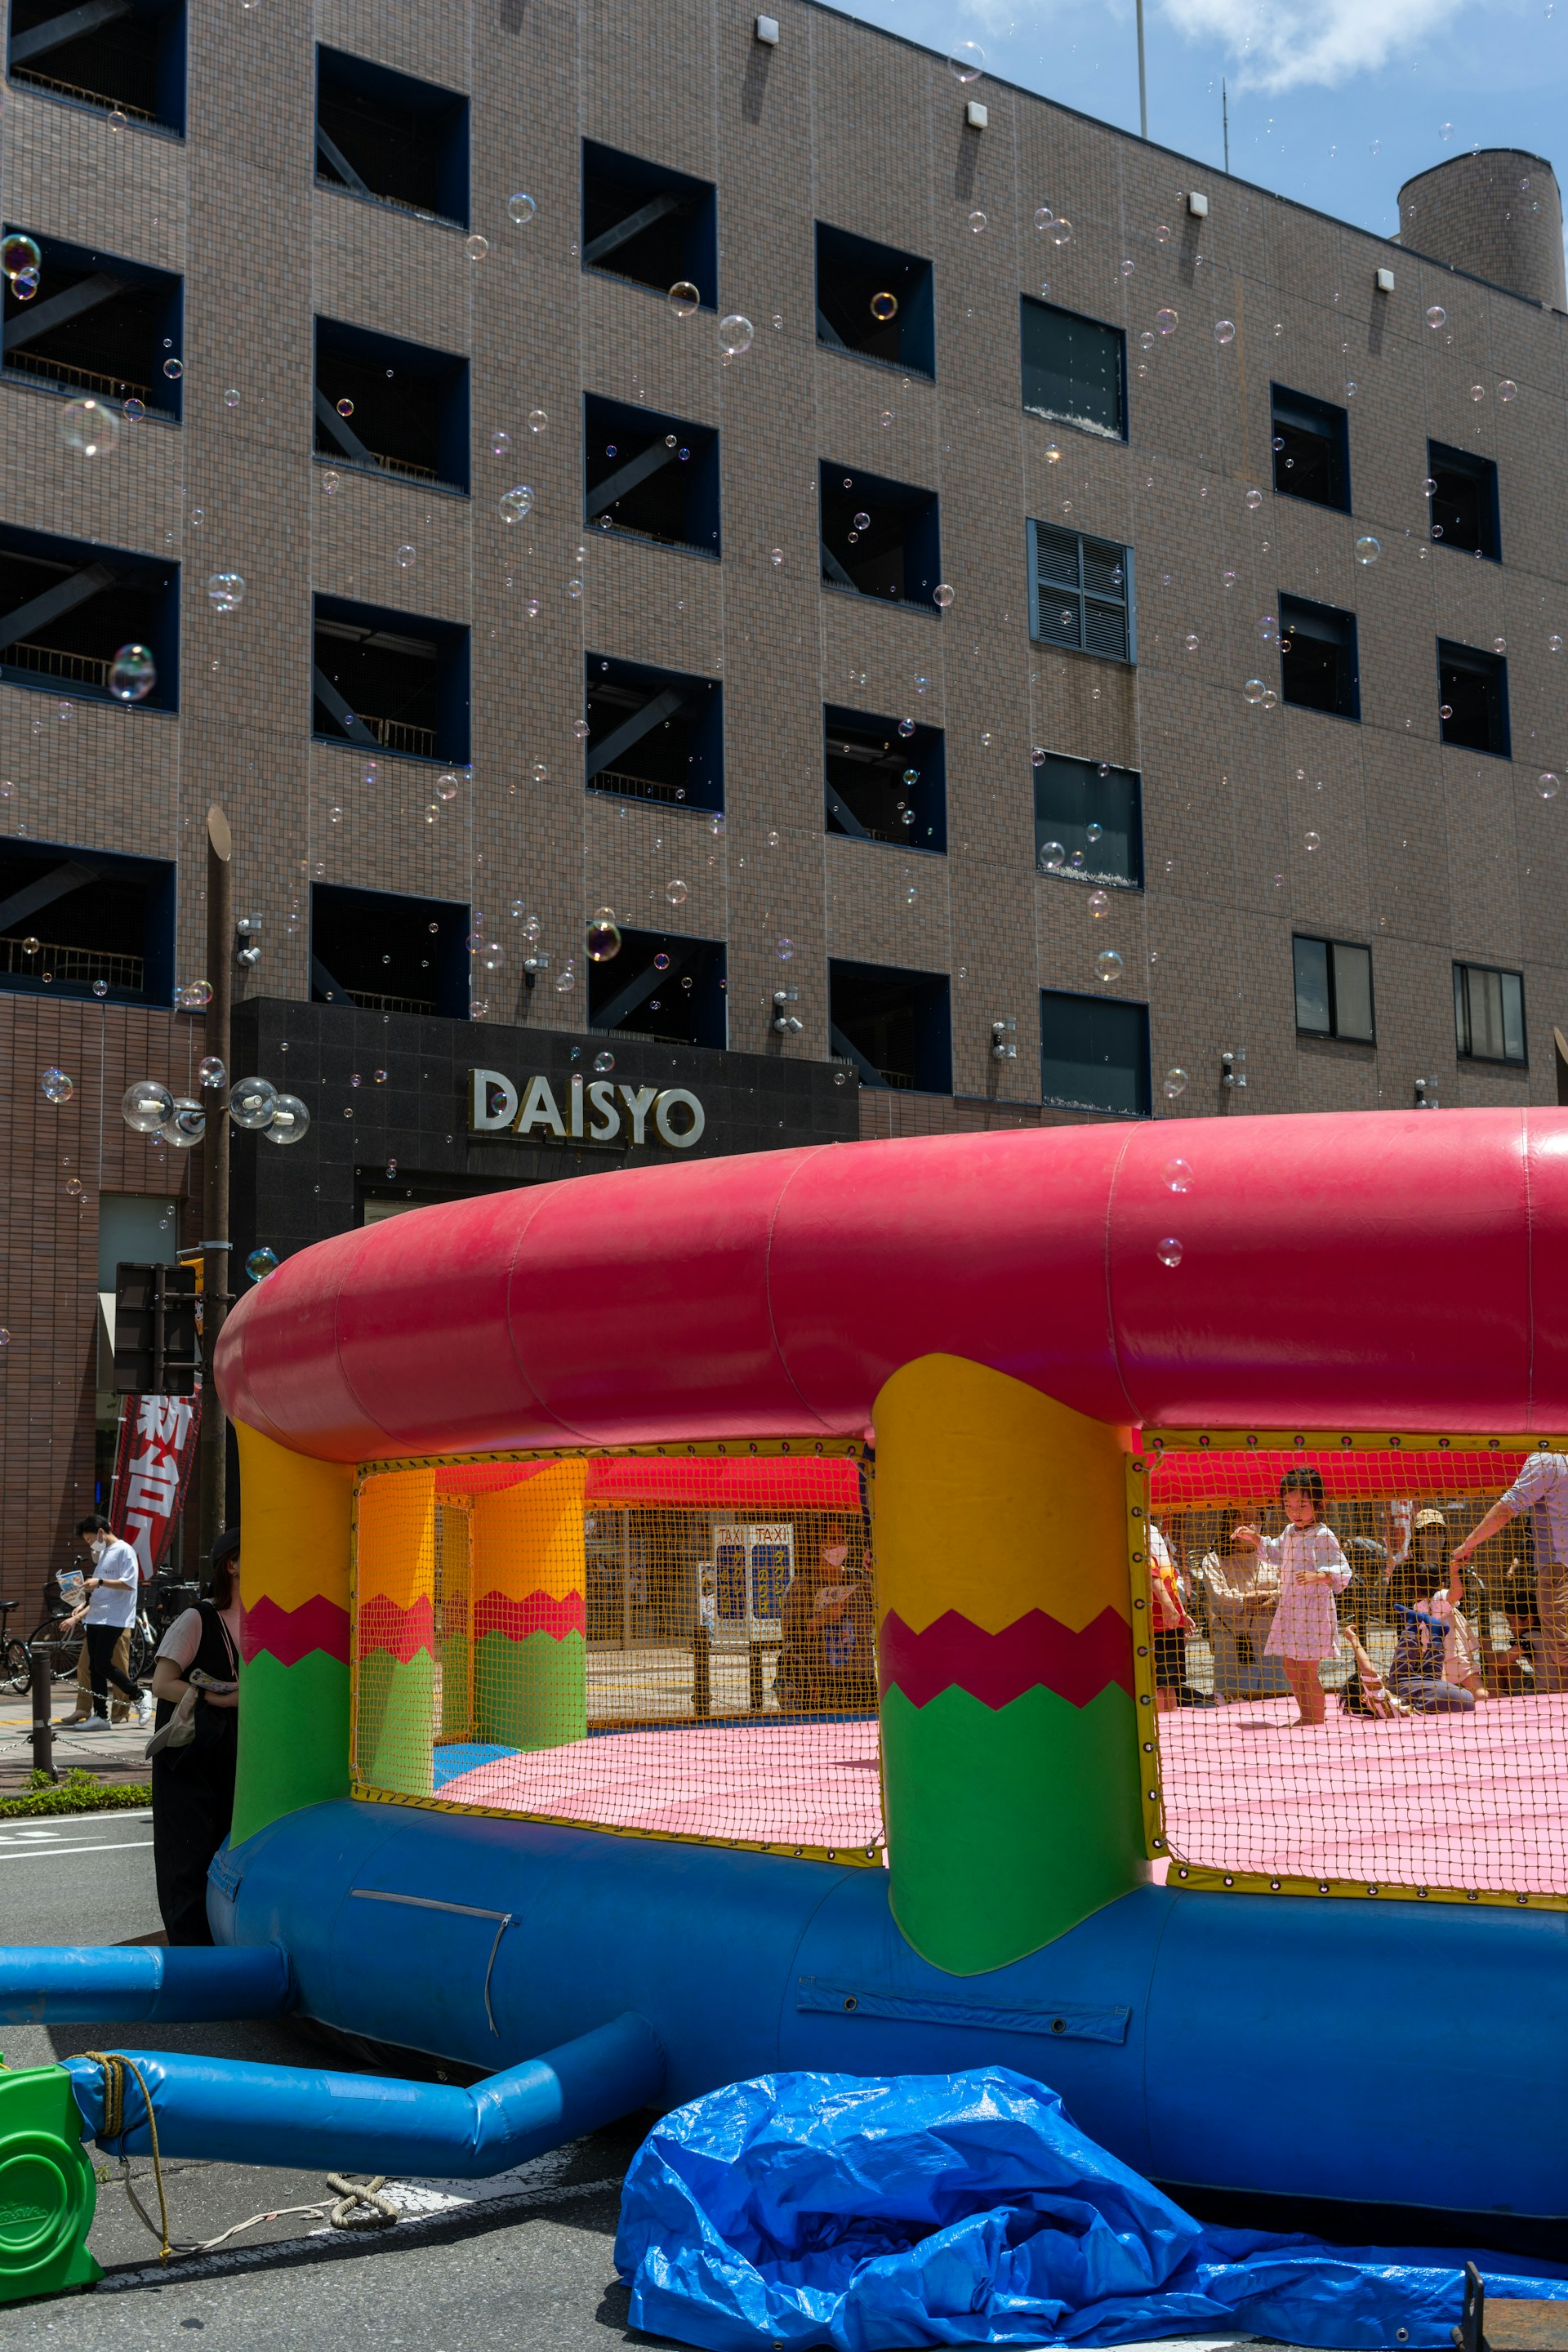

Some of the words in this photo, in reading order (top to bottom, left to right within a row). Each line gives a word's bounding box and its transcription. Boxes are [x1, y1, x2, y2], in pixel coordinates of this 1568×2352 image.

[469, 1068, 705, 1148] DAISYO
[127, 1441, 137, 1459] NEW
[719, 1529, 743, 1543] TAXI
[756, 1528, 786, 1542] TAXI
[759, 1569, 769, 1613] のりば
[774, 1551, 785, 1610] タクシー
